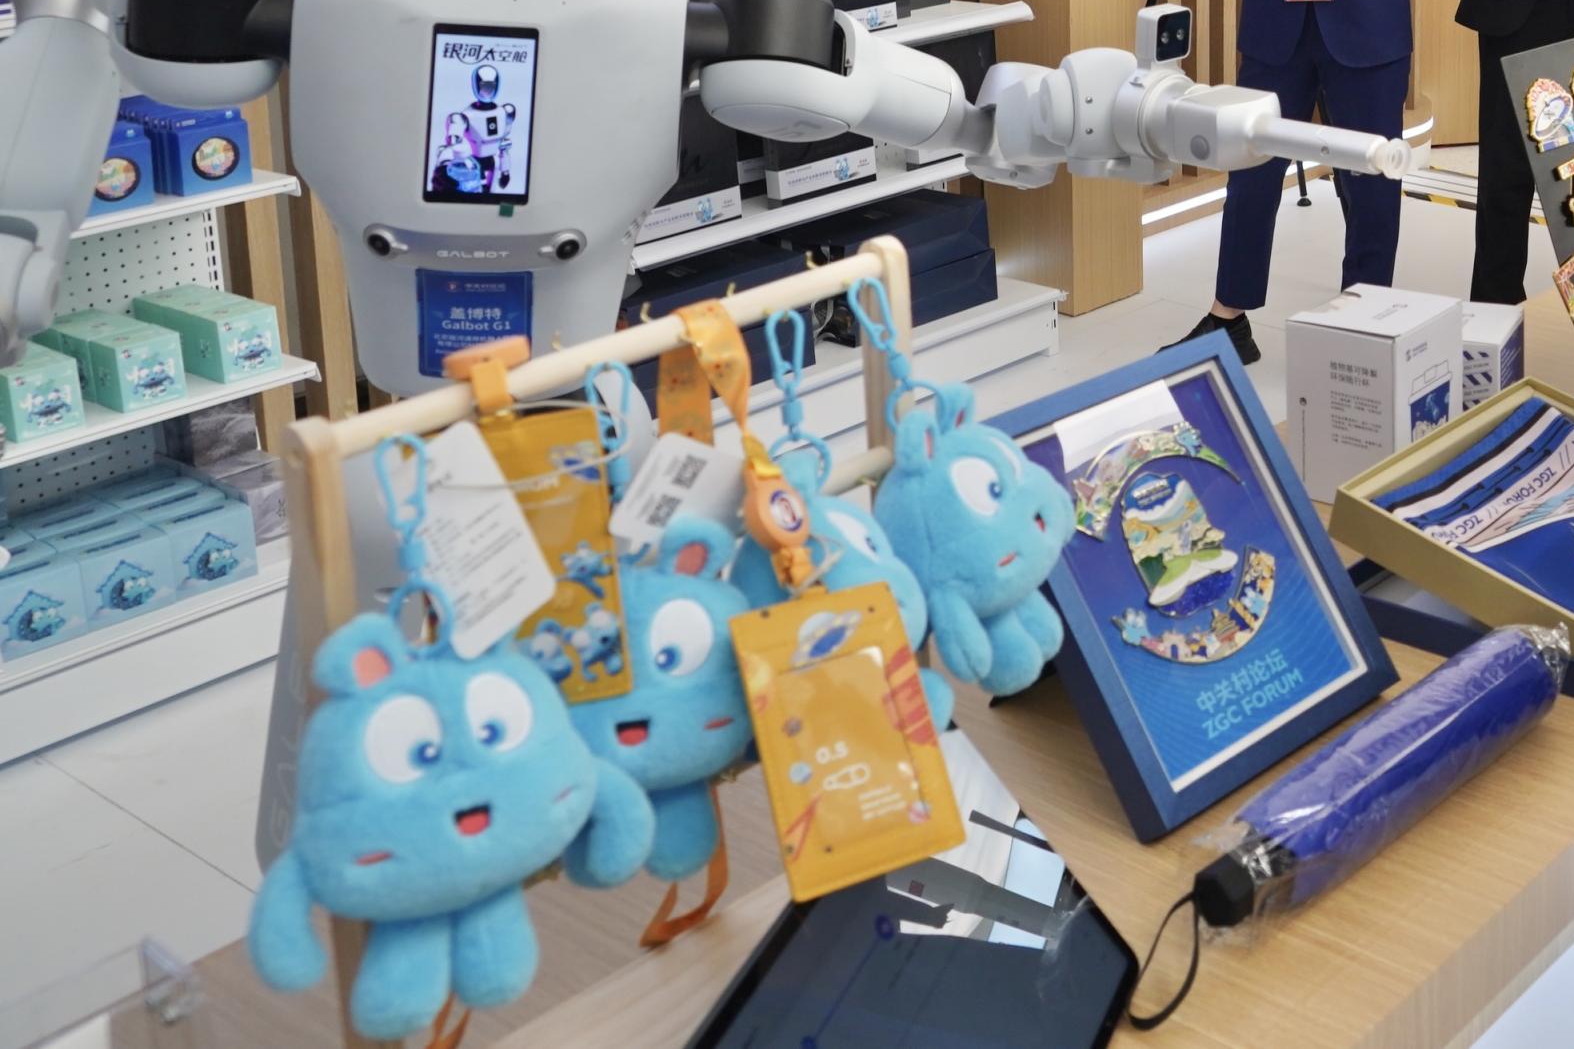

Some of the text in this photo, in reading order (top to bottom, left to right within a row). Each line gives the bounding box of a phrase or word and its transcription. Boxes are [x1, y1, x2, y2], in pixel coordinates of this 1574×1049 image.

[436, 249, 510, 259] GALBOT
[449, 306, 502, 321] 盖博特
[441, 319, 511, 331] Galbot G1
[1533, 467, 1557, 489] ZGC
[1455, 514, 1483, 535] ZGC
[1196, 648, 1288, 714] 中关村论坛
[1202, 667, 1304, 740] ZGC FORUM
